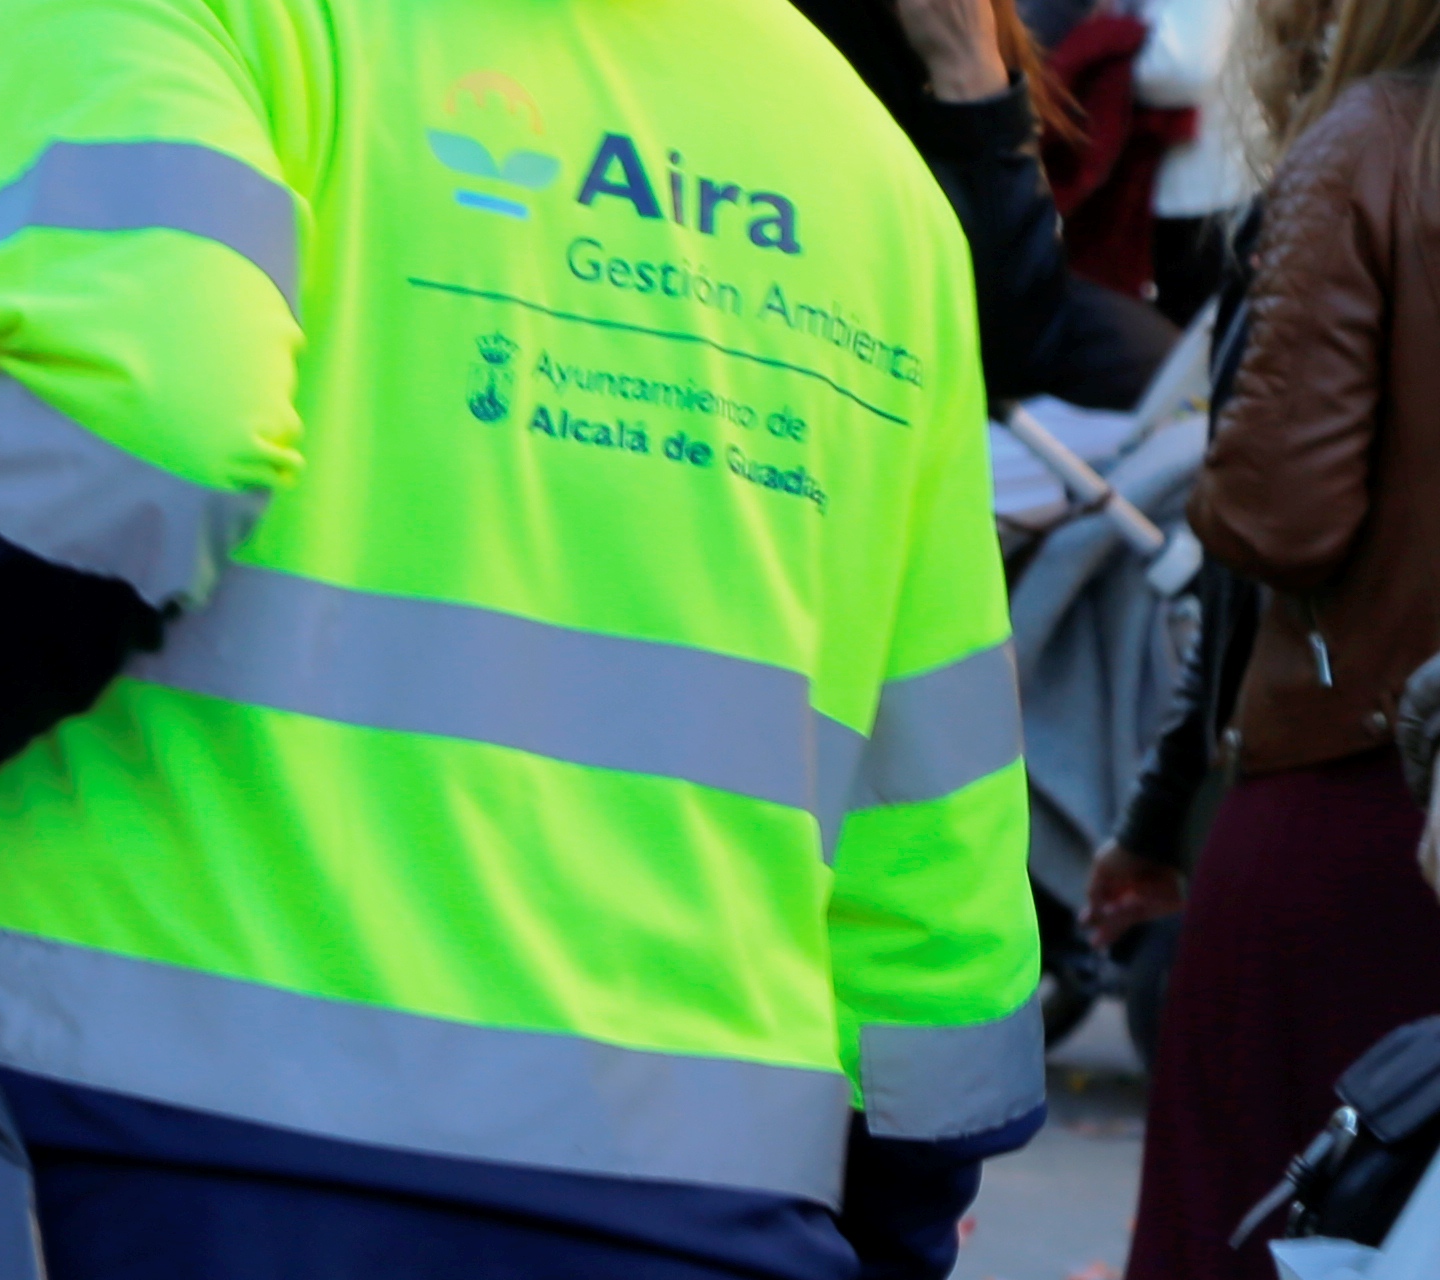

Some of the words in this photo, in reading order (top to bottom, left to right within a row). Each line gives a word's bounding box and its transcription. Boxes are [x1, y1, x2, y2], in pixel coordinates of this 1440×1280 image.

[575, 129, 803, 256] Aira
[567, 237, 742, 317] Gestión
[761, 282, 924, 389] Ambienta
[529, 404, 650, 455] Alcalá
[661, 431, 714, 467] de
[766, 406, 808, 443] de
